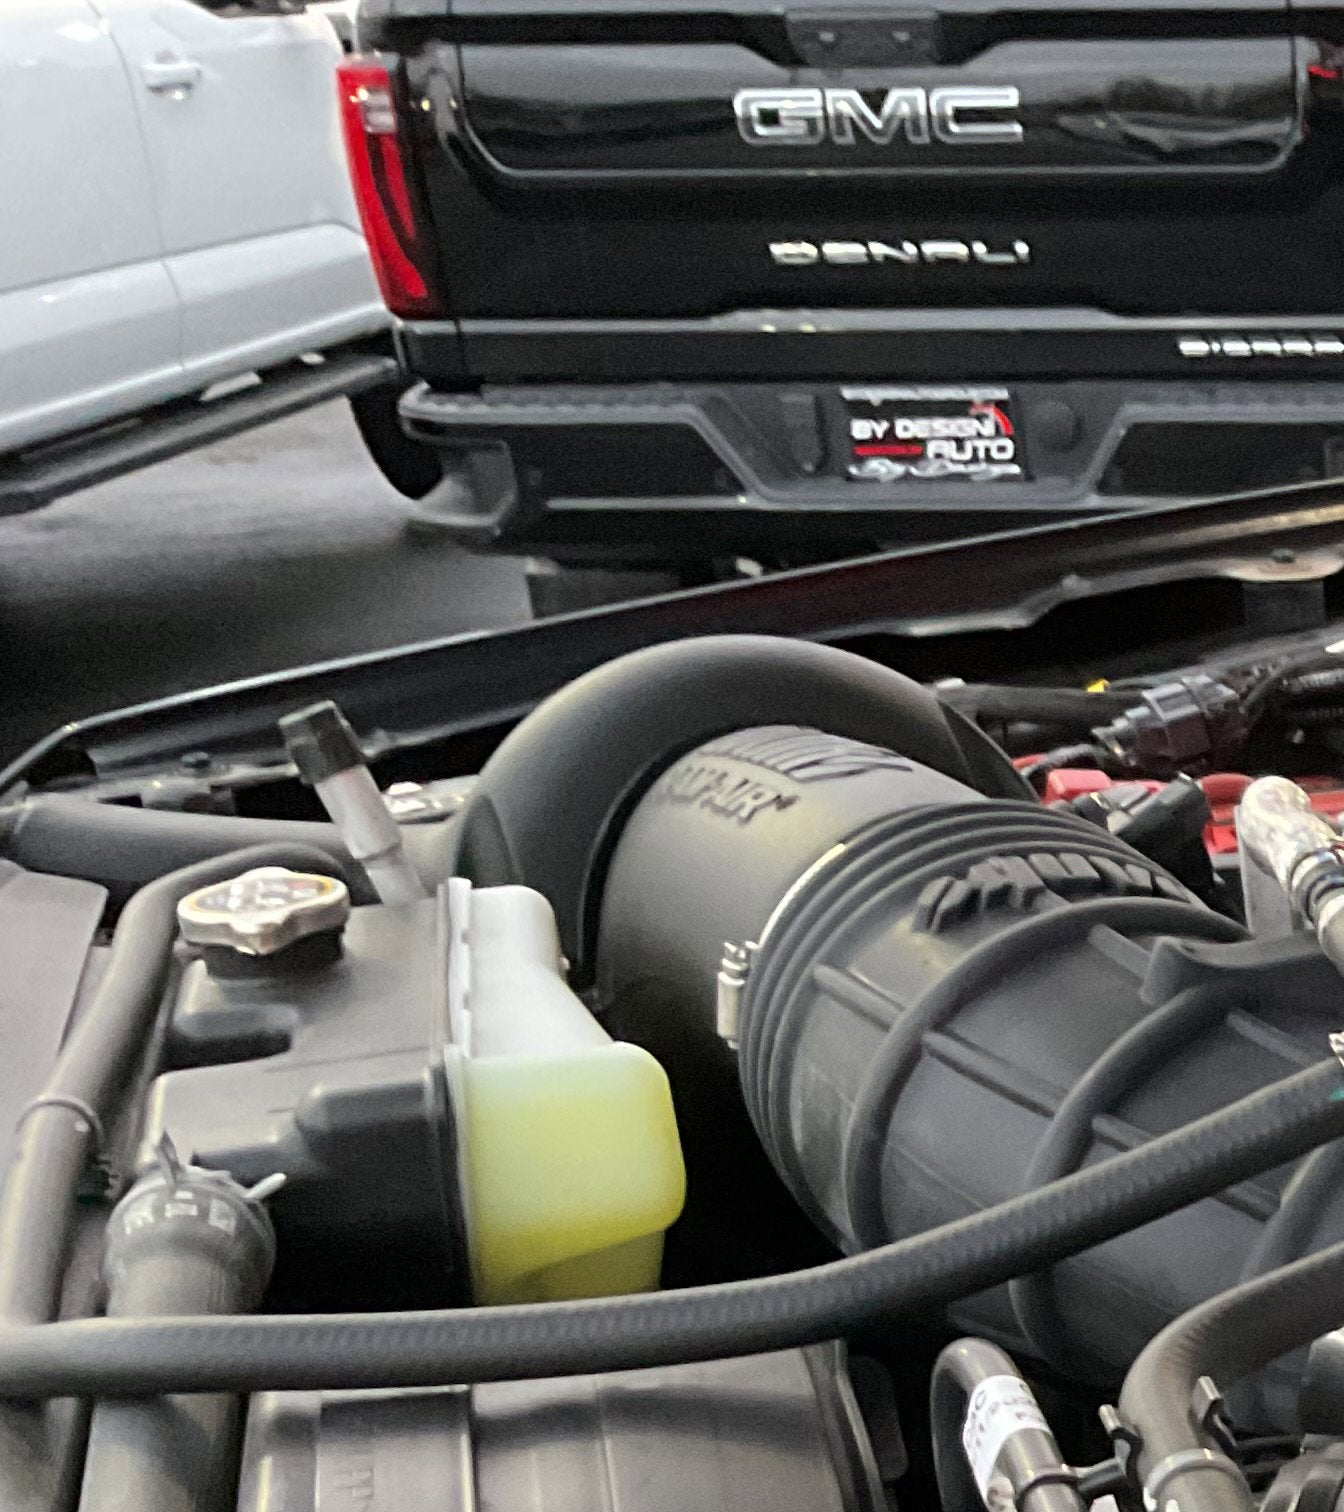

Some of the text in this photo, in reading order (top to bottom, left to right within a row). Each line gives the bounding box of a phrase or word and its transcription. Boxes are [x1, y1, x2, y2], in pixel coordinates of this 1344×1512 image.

[733, 87, 1024, 145] GMC
[768, 240, 1030, 265] DENALI
[851, 416, 996, 440] BY DESIGN
[926, 437, 1015, 461] AUTO
